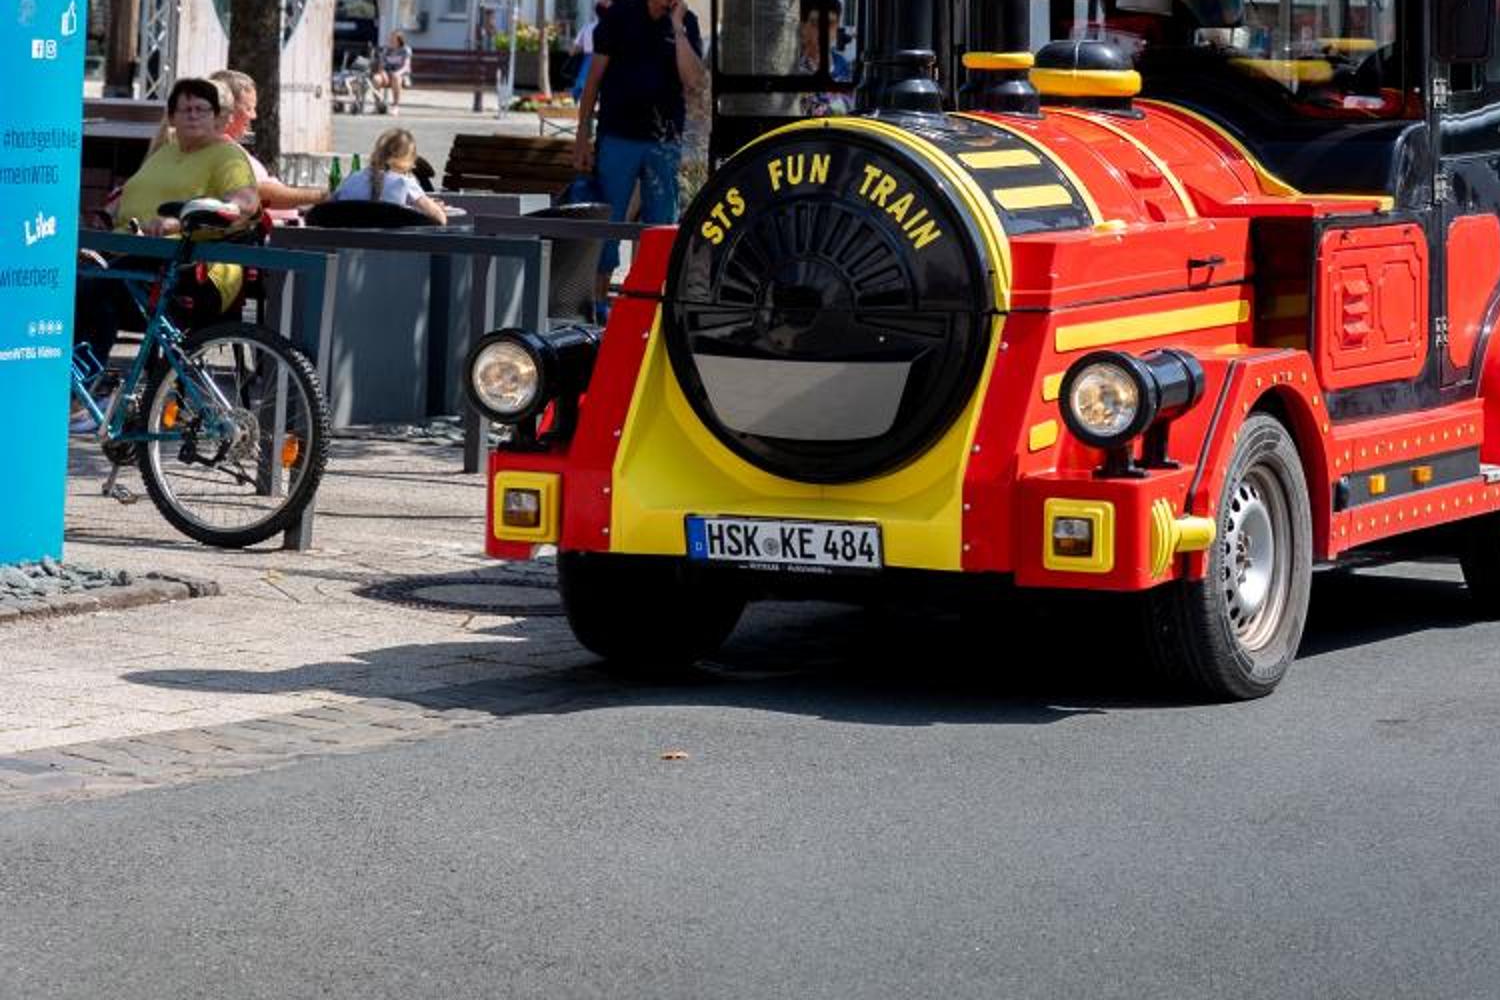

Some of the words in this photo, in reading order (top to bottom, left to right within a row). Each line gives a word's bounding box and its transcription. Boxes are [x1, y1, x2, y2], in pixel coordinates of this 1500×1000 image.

[701, 187, 746, 245] STS
[767, 153, 831, 191] FUN
[858, 163, 943, 250] TRAIN
[24, 211, 57, 246] Like
[707, 523, 761, 557] HSK
[781, 526, 816, 560] KE
[824, 529, 875, 563] 484
